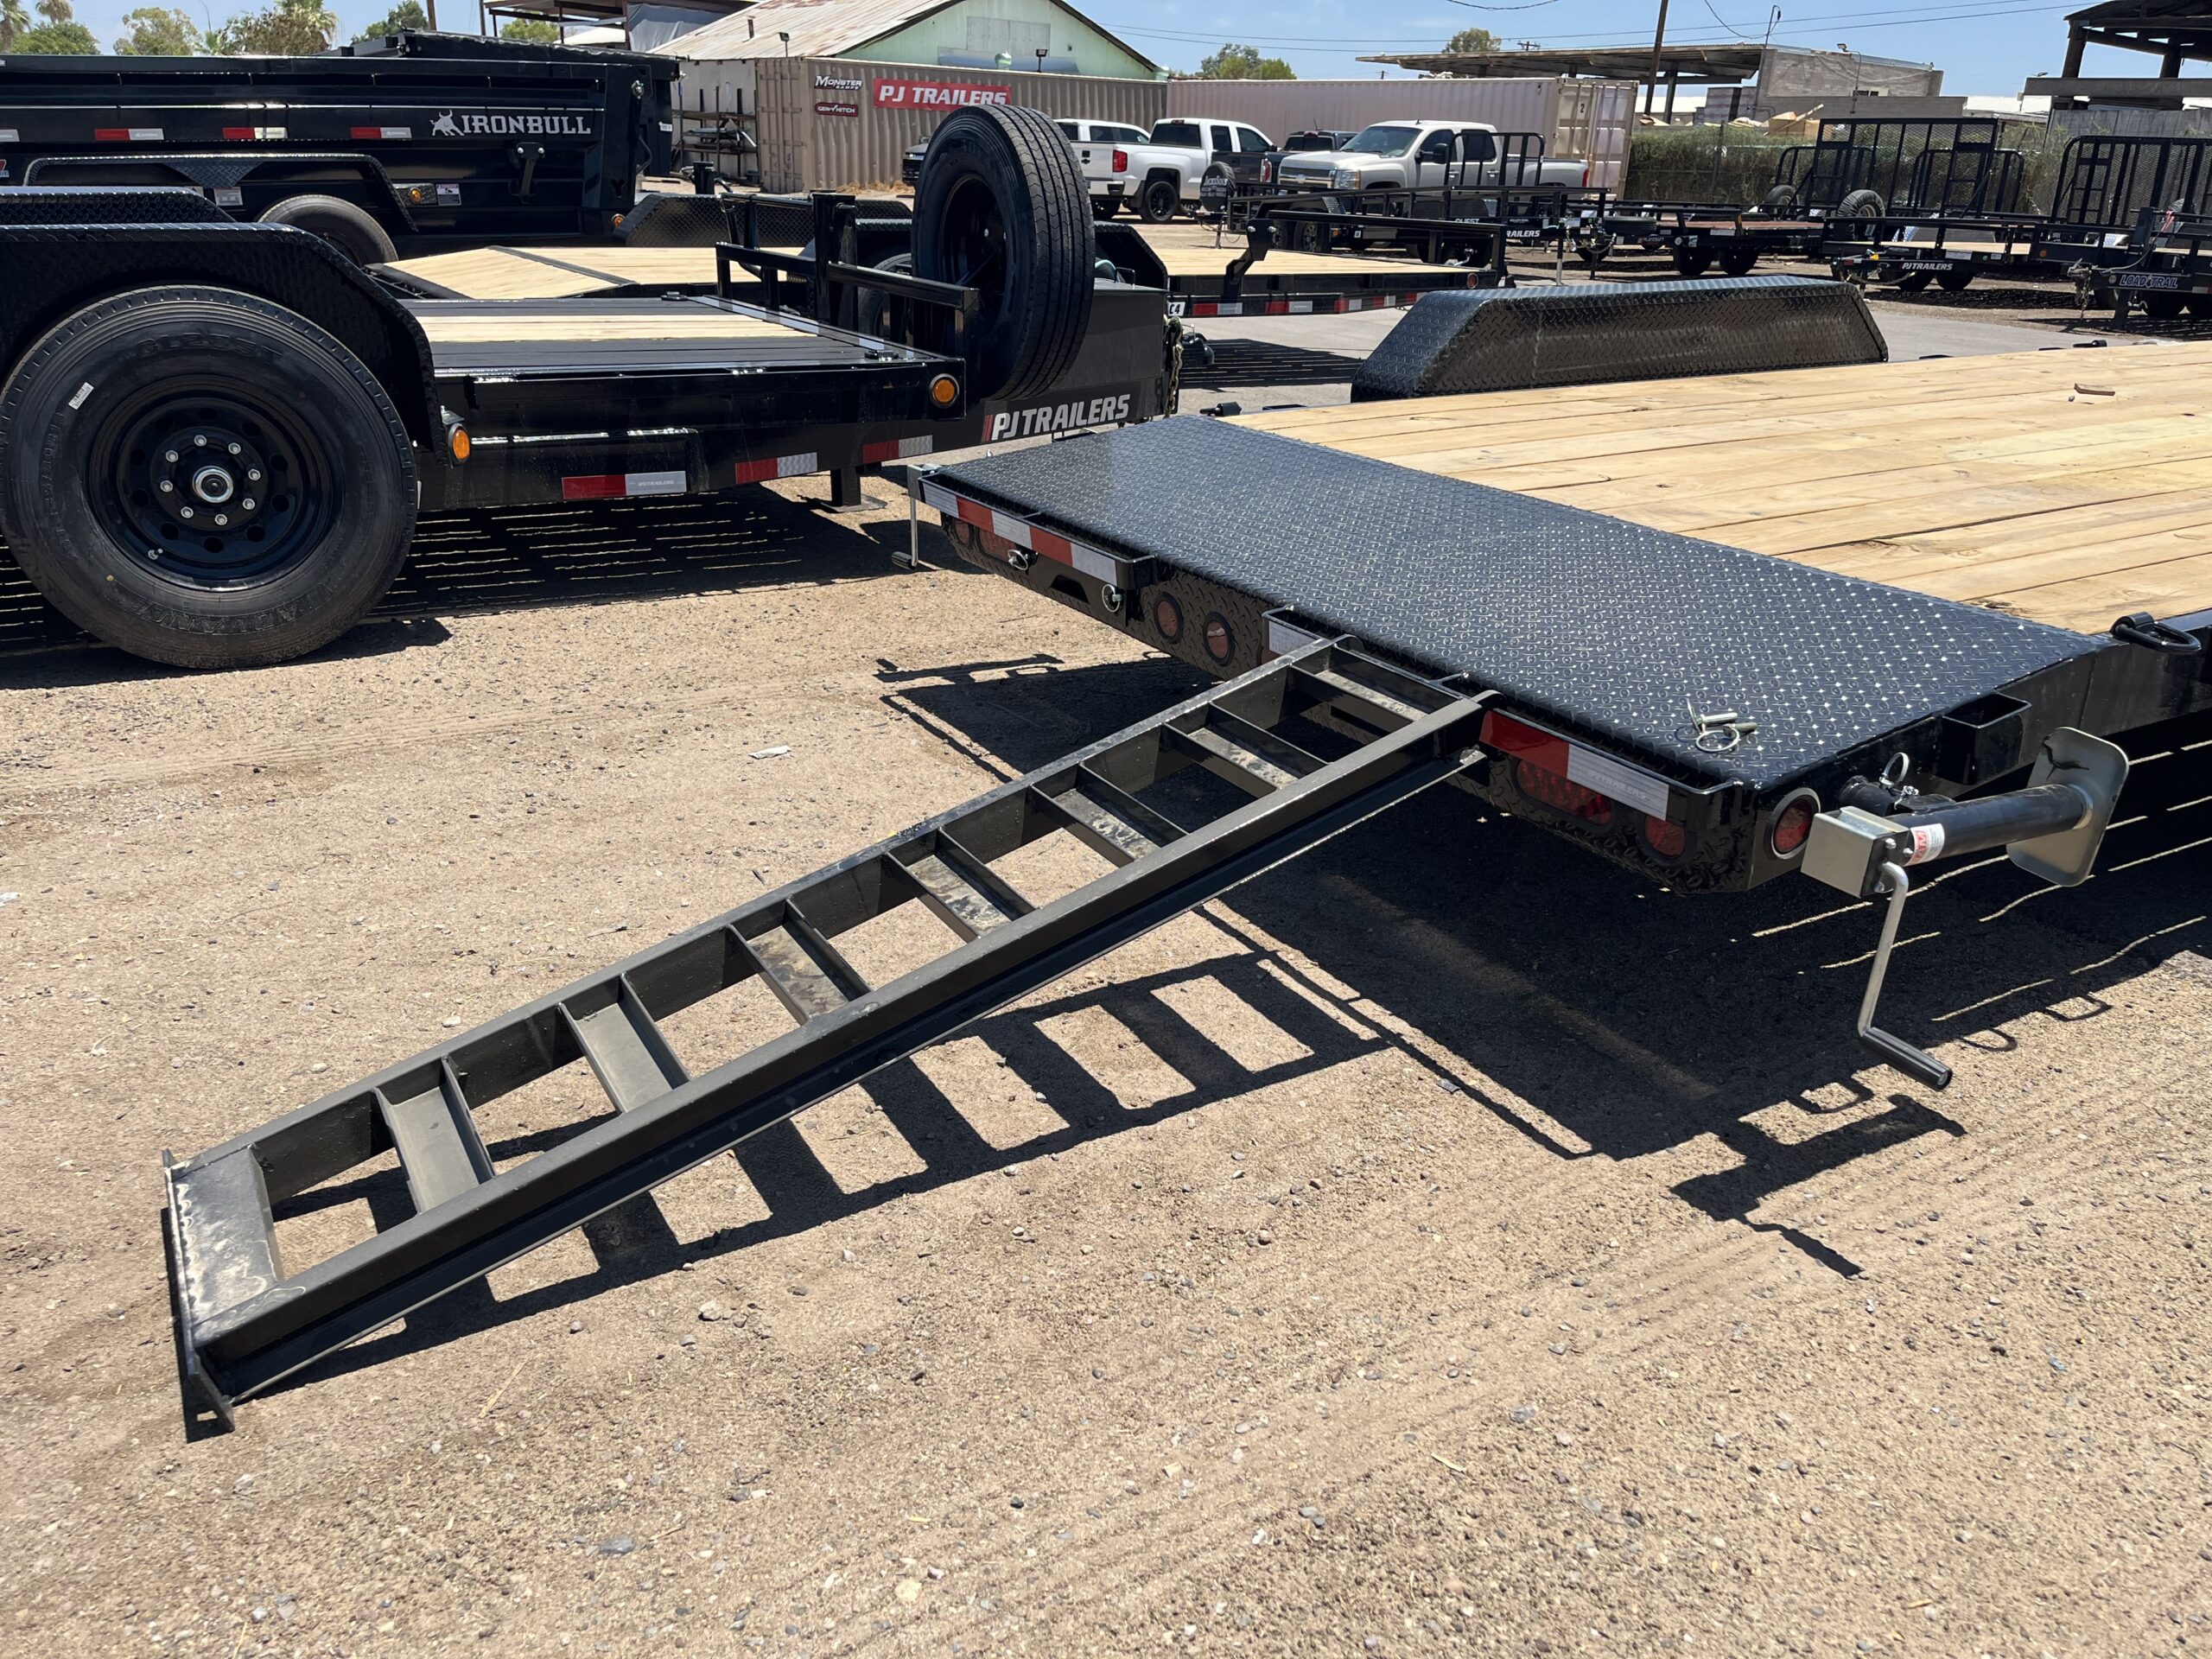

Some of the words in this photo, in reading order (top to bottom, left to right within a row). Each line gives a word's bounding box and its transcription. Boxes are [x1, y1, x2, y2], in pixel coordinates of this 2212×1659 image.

[879, 85, 906, 102] PJ
[912, 87, 1007, 105] TRAILERS
[1580, 104, 1586, 113] 2
[461, 115, 591, 134] IRONBULL
[2120, 275, 2146, 287] LOAD
[2152, 276, 2178, 289] TRAIL
